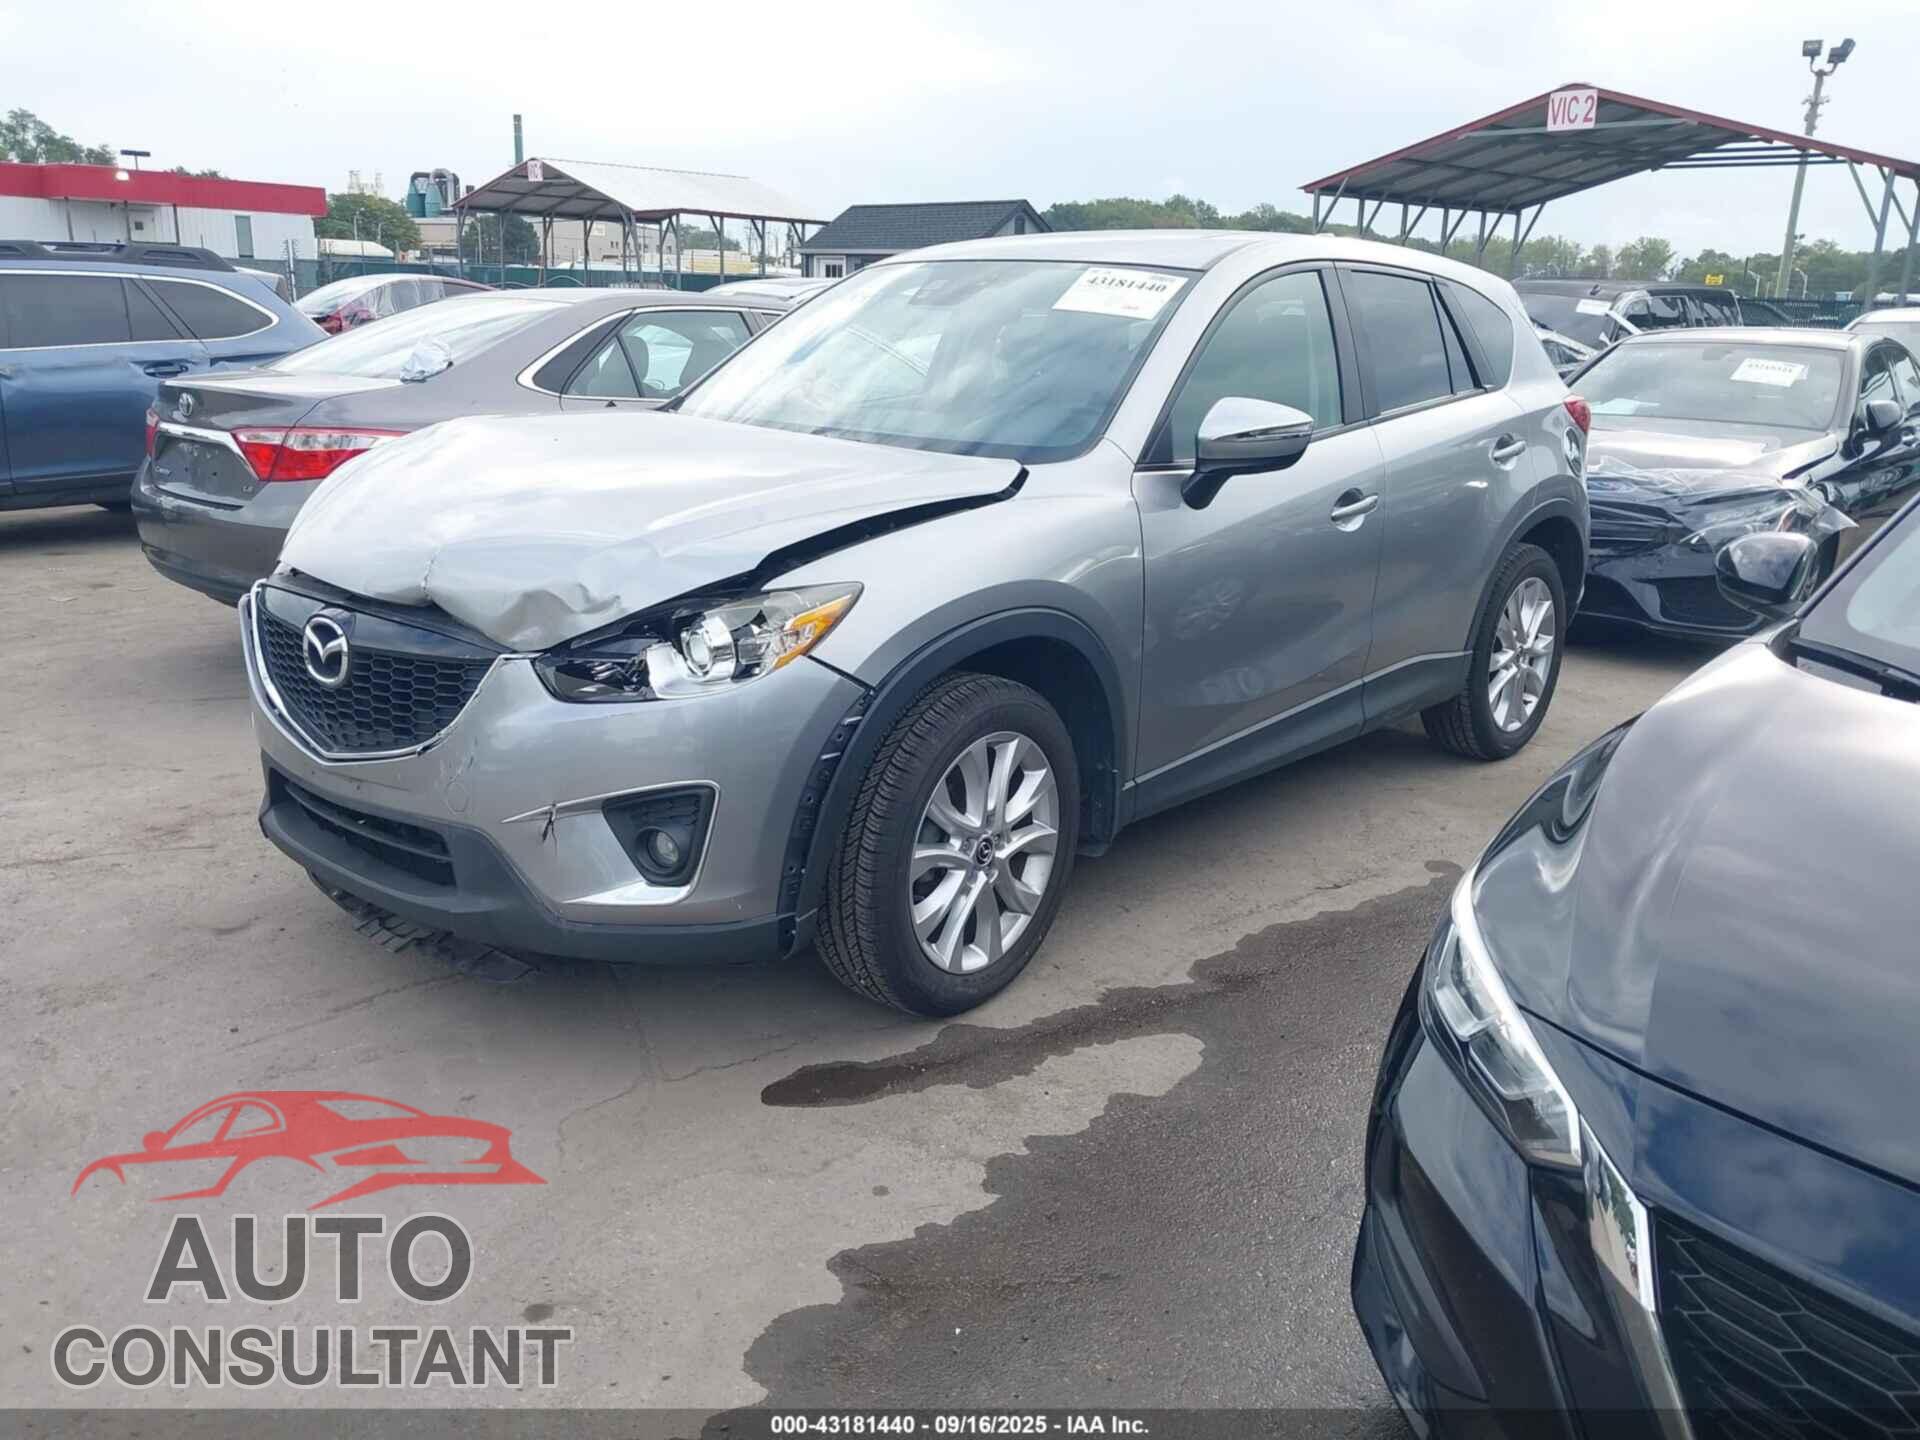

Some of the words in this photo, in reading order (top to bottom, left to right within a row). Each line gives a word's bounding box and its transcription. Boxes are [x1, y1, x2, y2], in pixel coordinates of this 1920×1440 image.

[1551, 96, 1580, 125] VIC
[1583, 95, 1595, 123] 2
[1088, 275, 1168, 293] 43181440
